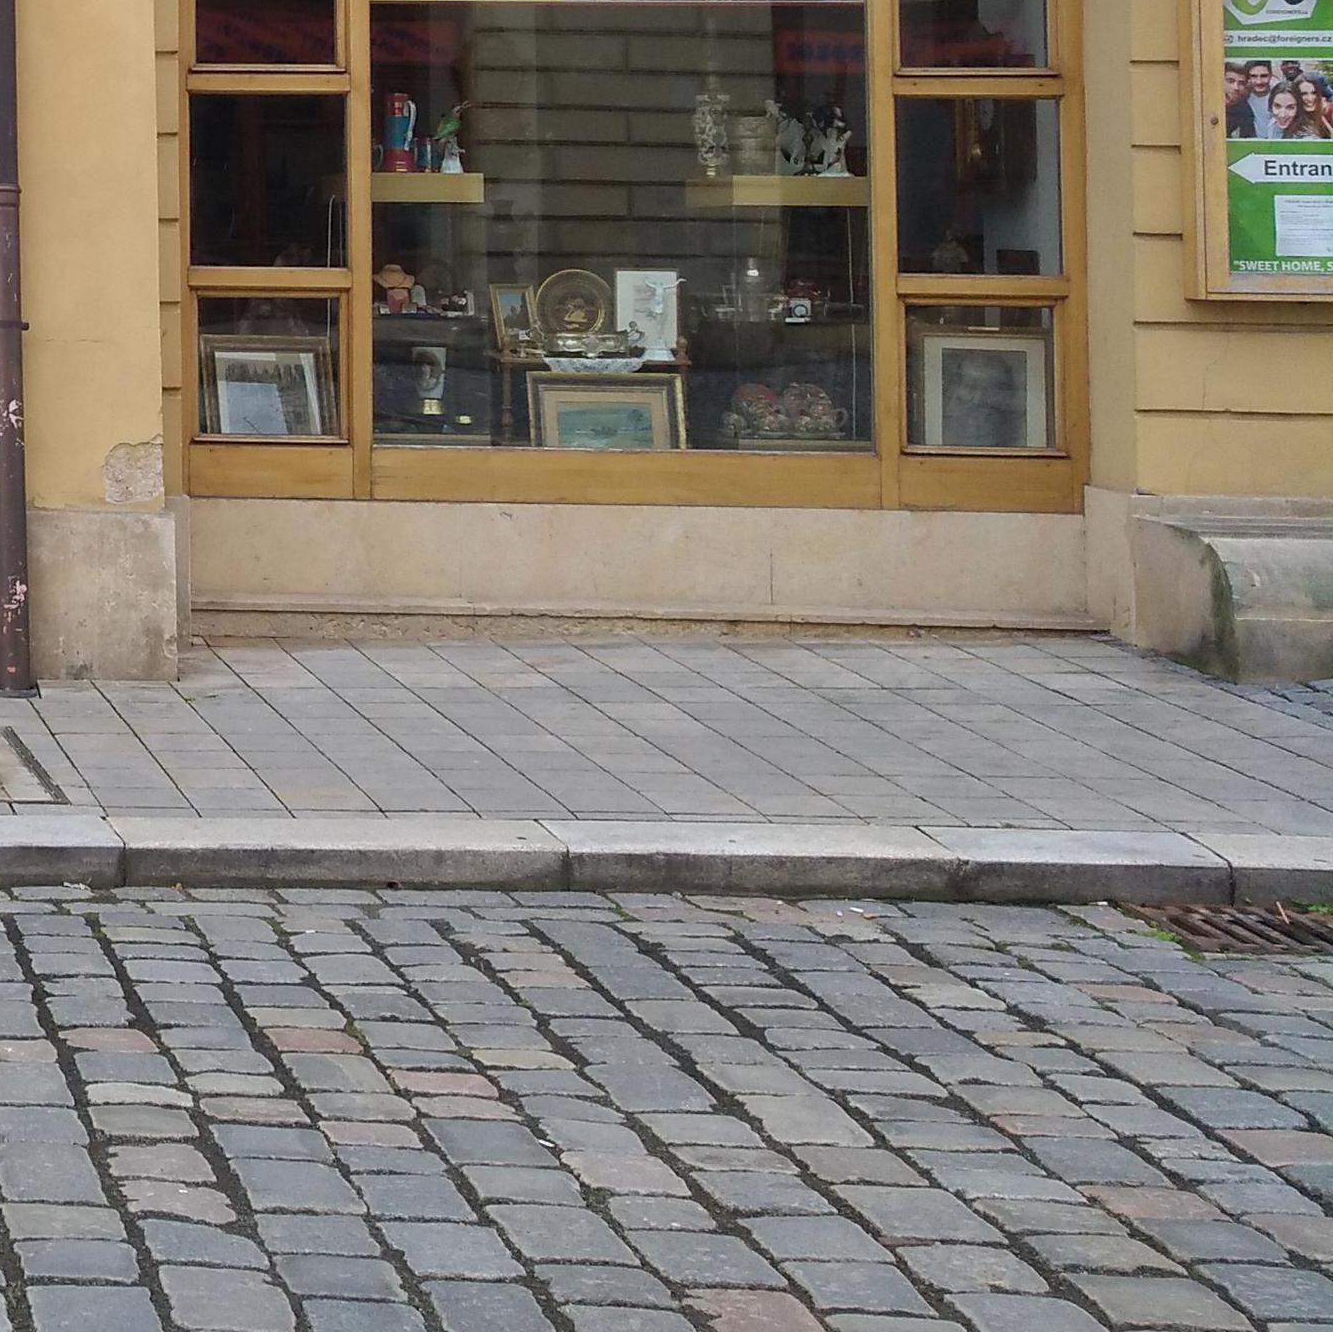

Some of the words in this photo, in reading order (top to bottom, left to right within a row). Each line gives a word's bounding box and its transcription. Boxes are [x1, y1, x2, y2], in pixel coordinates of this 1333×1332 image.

[1237, 34, 1332, 44] hradec@foreigners.cz
[1264, 159, 1333, 176] Entran
[1281, 260, 1325, 272] HOME,
